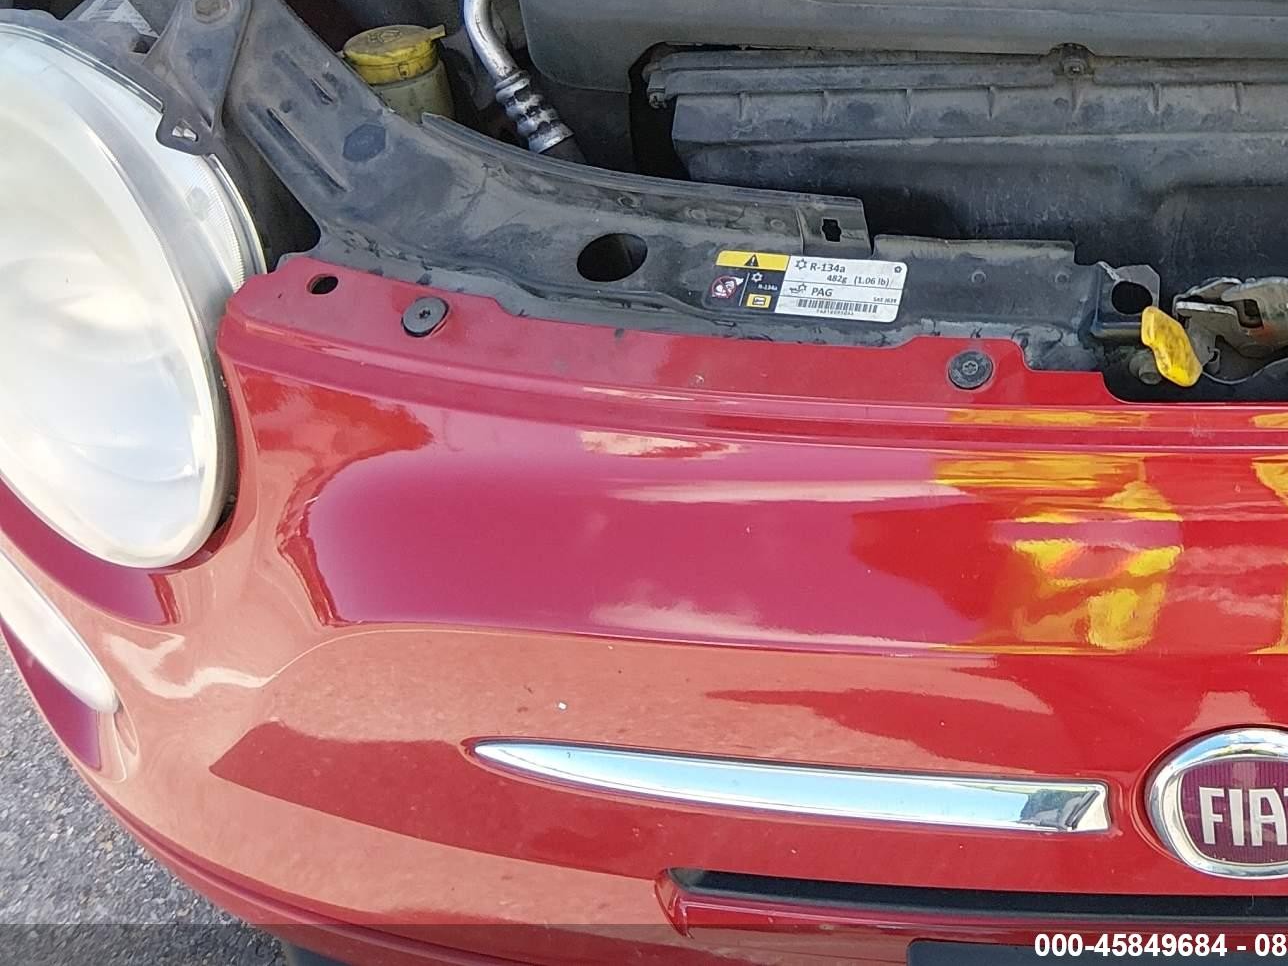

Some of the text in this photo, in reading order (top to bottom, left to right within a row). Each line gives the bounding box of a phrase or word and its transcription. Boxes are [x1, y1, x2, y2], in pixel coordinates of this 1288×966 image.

[810, 262, 846, 273] R-134a
[826, 274, 890, 287] 482g (1.06 lb)
[811, 287, 833, 297] PAG
